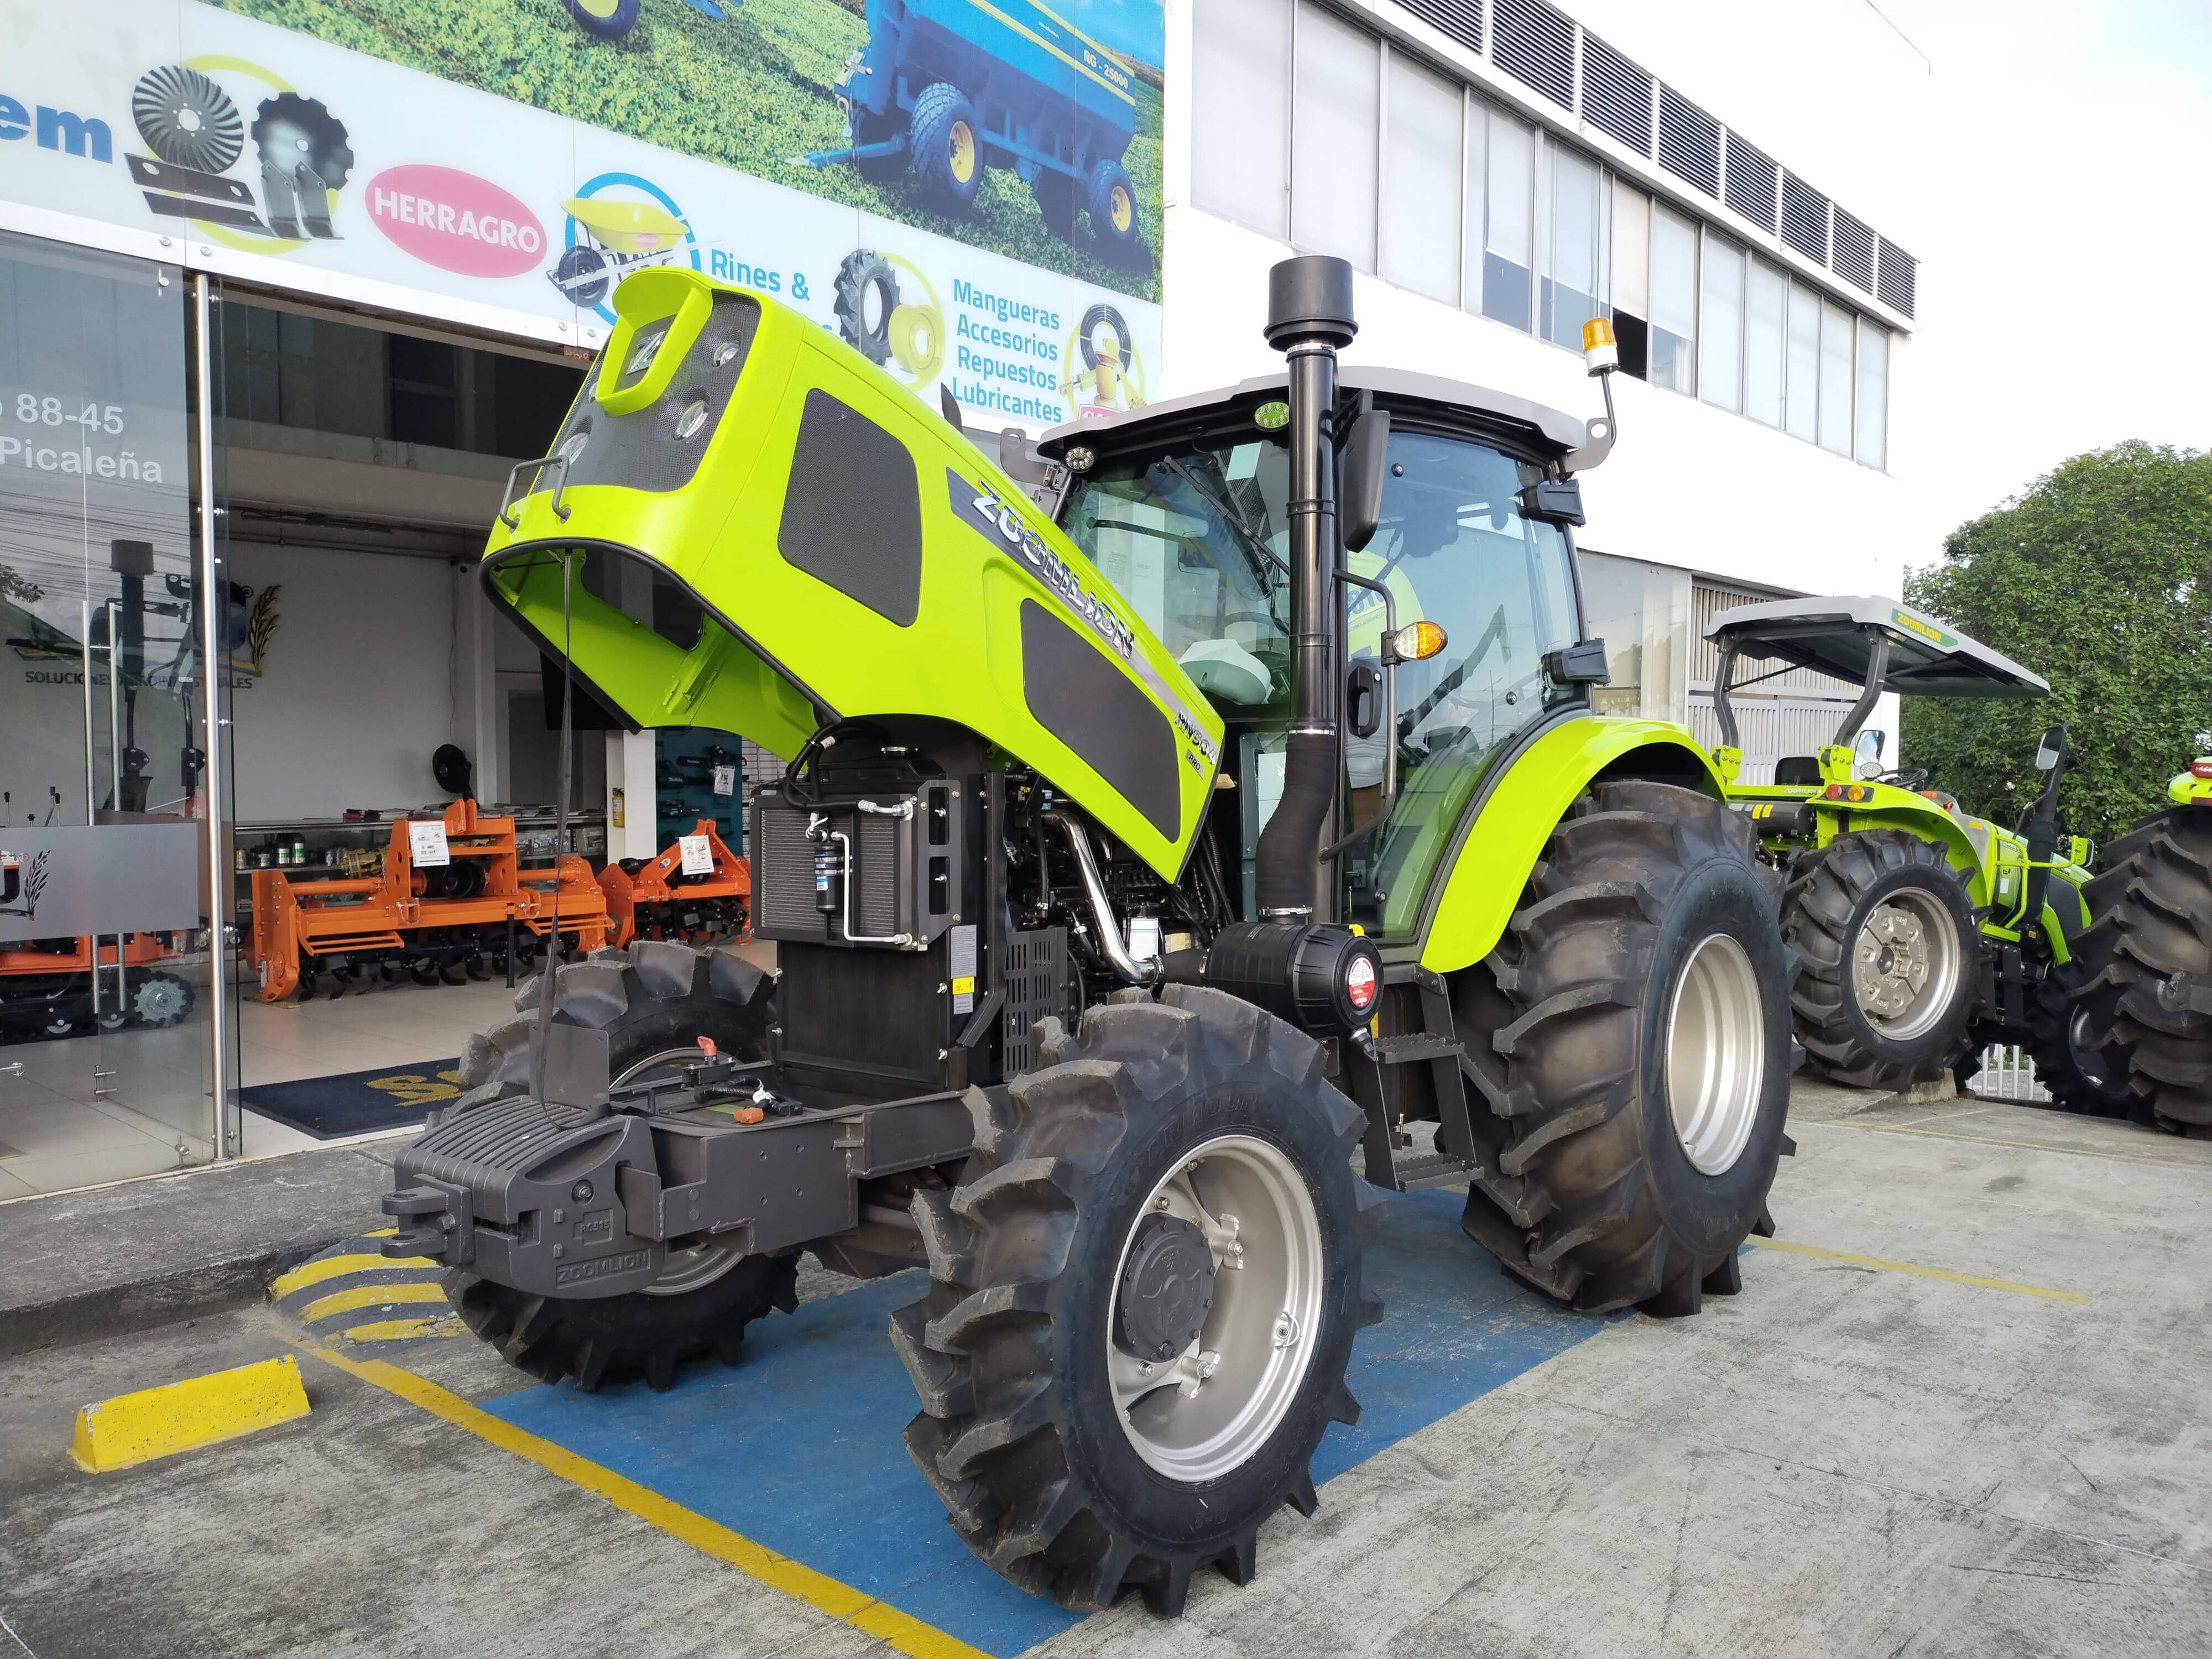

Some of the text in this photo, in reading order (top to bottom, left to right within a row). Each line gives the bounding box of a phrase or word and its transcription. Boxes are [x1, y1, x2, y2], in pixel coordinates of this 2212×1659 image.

[1083, 49, 1097, 67] RG
[1103, 64, 1128, 89] 25000
[374, 186, 540, 253] HERRAGRO
[711, 248, 810, 301] Rines &
[954, 278, 1060, 331] Mangueras
[957, 314, 1057, 361] Accesorios
[958, 345, 1057, 390] Repuestos
[17, 393, 124, 434] 88-45
[952, 377, 1062, 423] Lubricantes
[0, 436, 162, 483] Picaleña
[971, 480, 1135, 659] ZOOMLION
[1897, 612, 1942, 643] ZOOMLION
[1188, 754, 1201, 770] PRO
[557, 1251, 647, 1283] ZOOMLION
